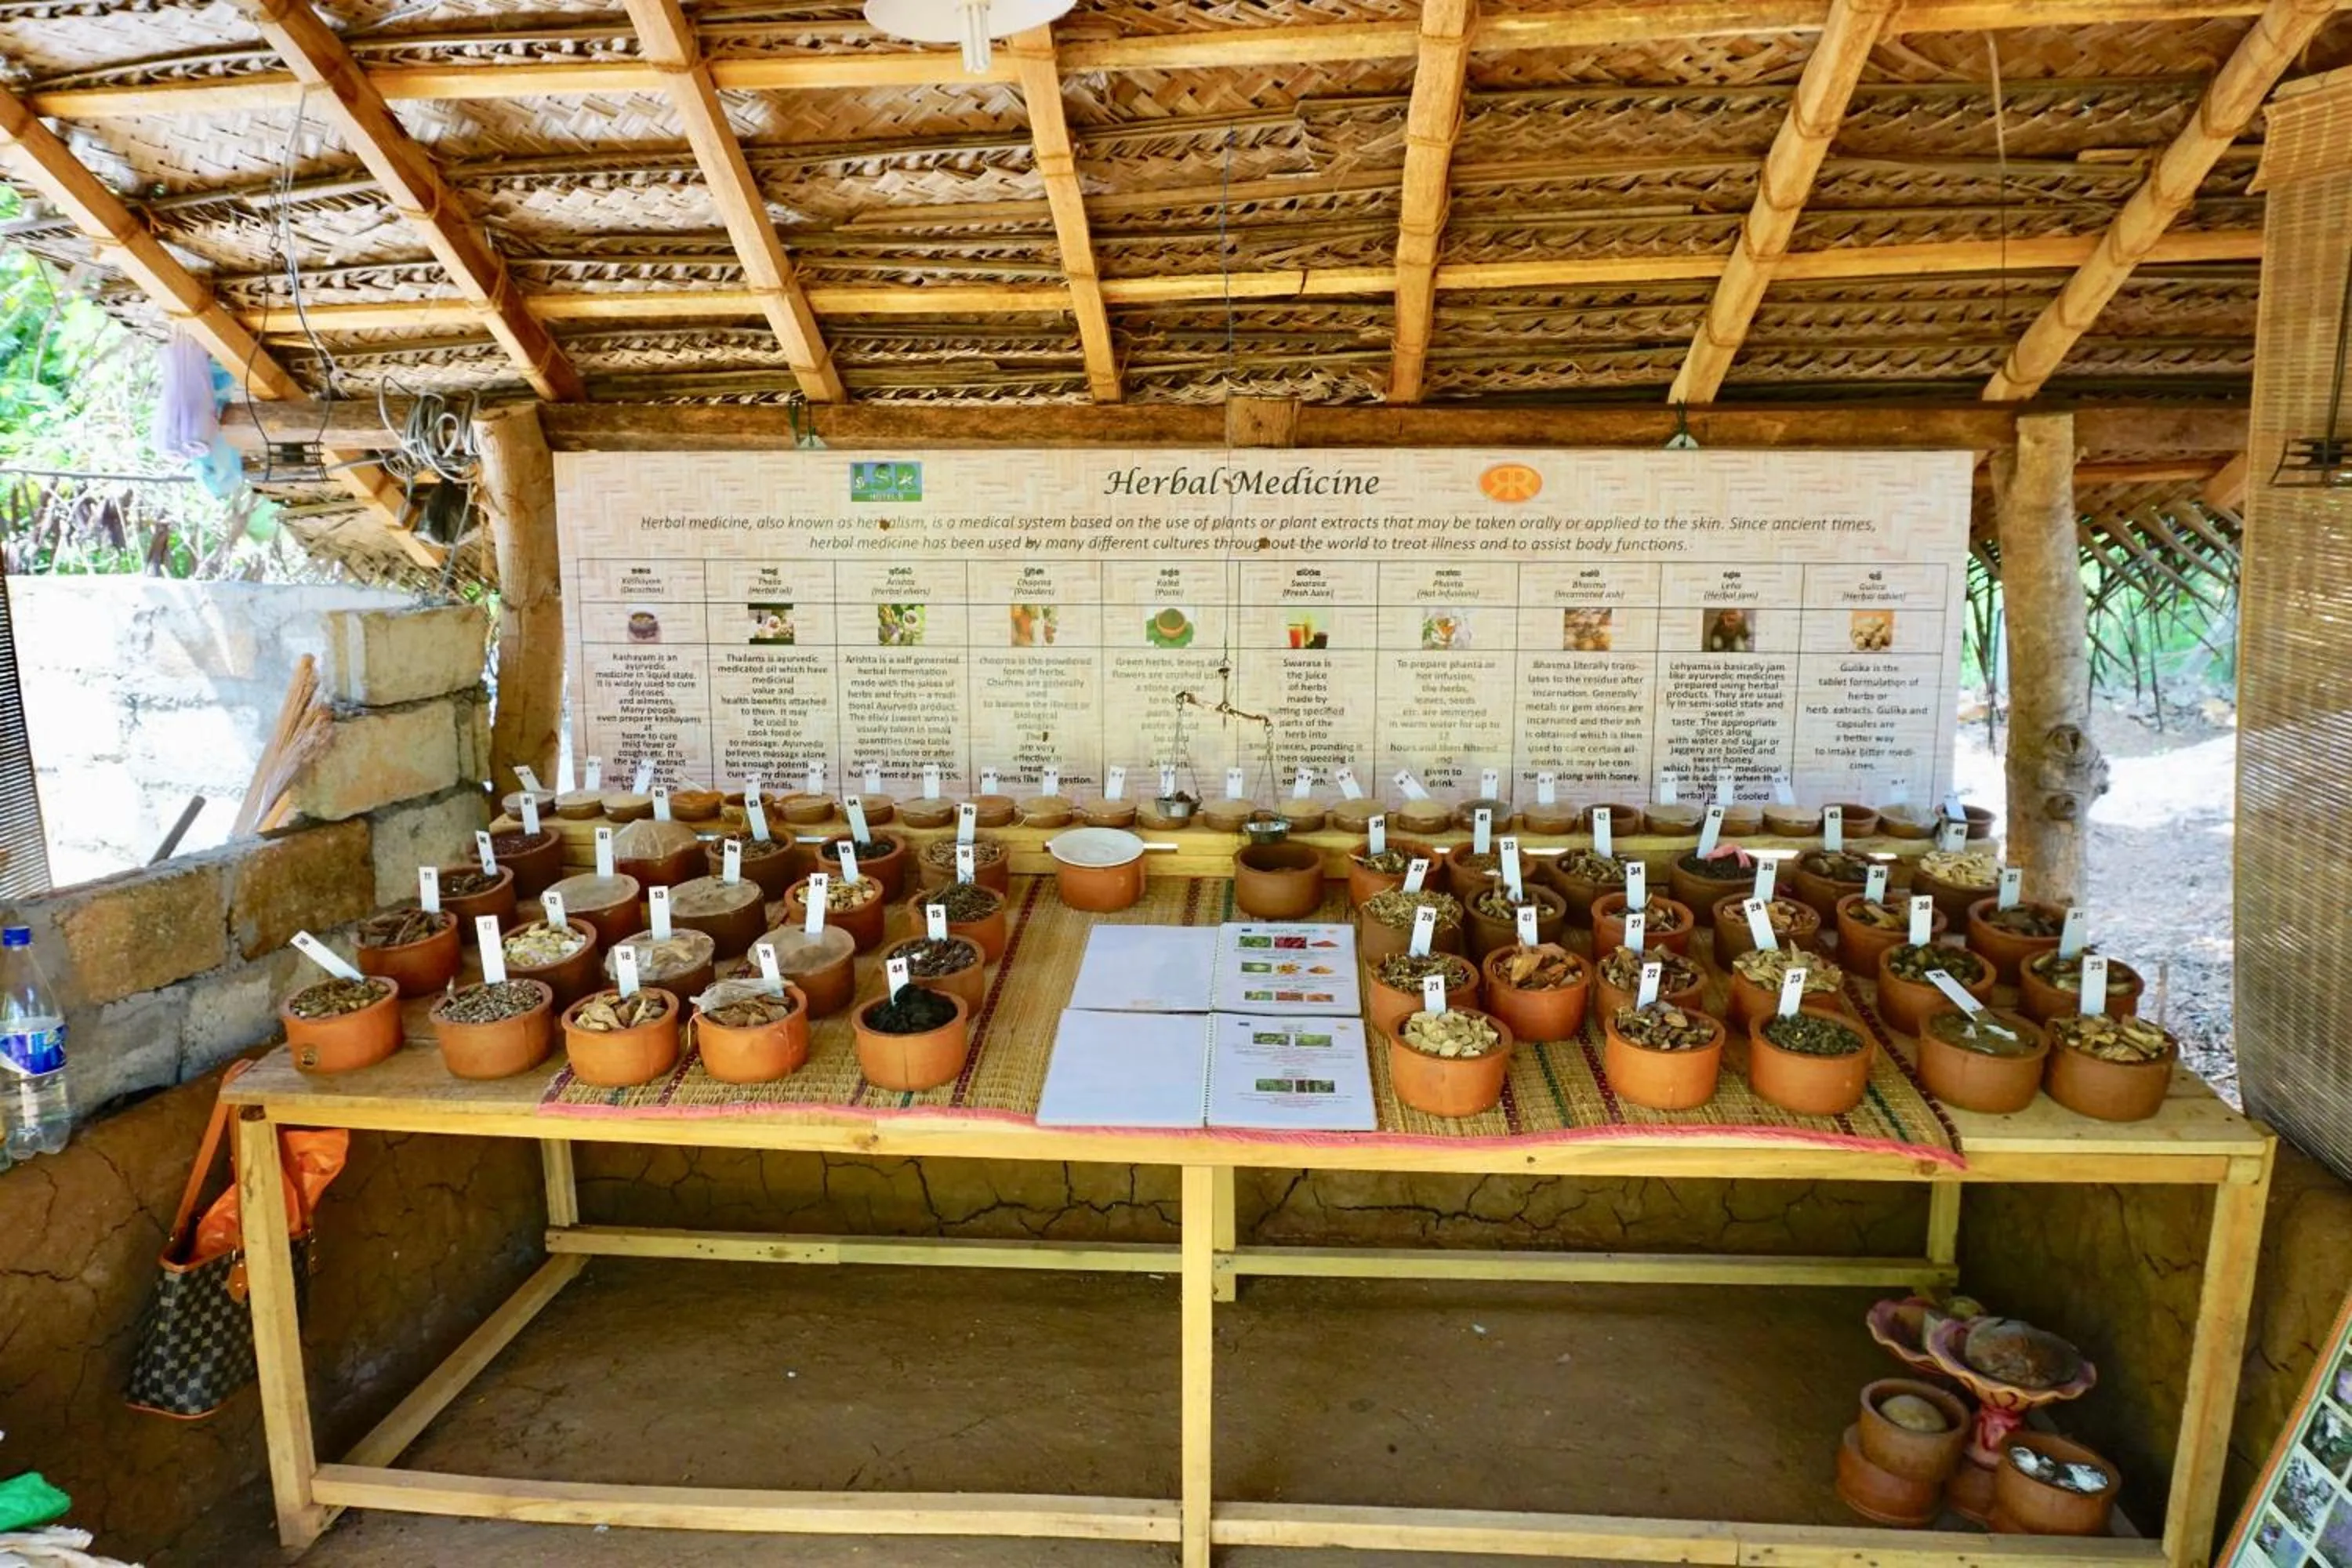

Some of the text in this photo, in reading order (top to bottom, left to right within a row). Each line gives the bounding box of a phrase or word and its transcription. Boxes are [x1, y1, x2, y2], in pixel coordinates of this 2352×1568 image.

[1104, 466, 1380, 495] Herbal Medicine
[641, 516, 1876, 532] Herbal medicine, also known as heralism, is a medical system based on the use of plants or plant extracts that may be taken orally or applied to the skin. Since ancient times,
[810, 536, 1687, 553] herbal medicine has been used by many different cultures througout the world to treat illness and to assist body functions.
[931, 909, 941, 918] 15
[1647, 968, 1657, 978] 22
[1429, 982, 1439, 991] 21
